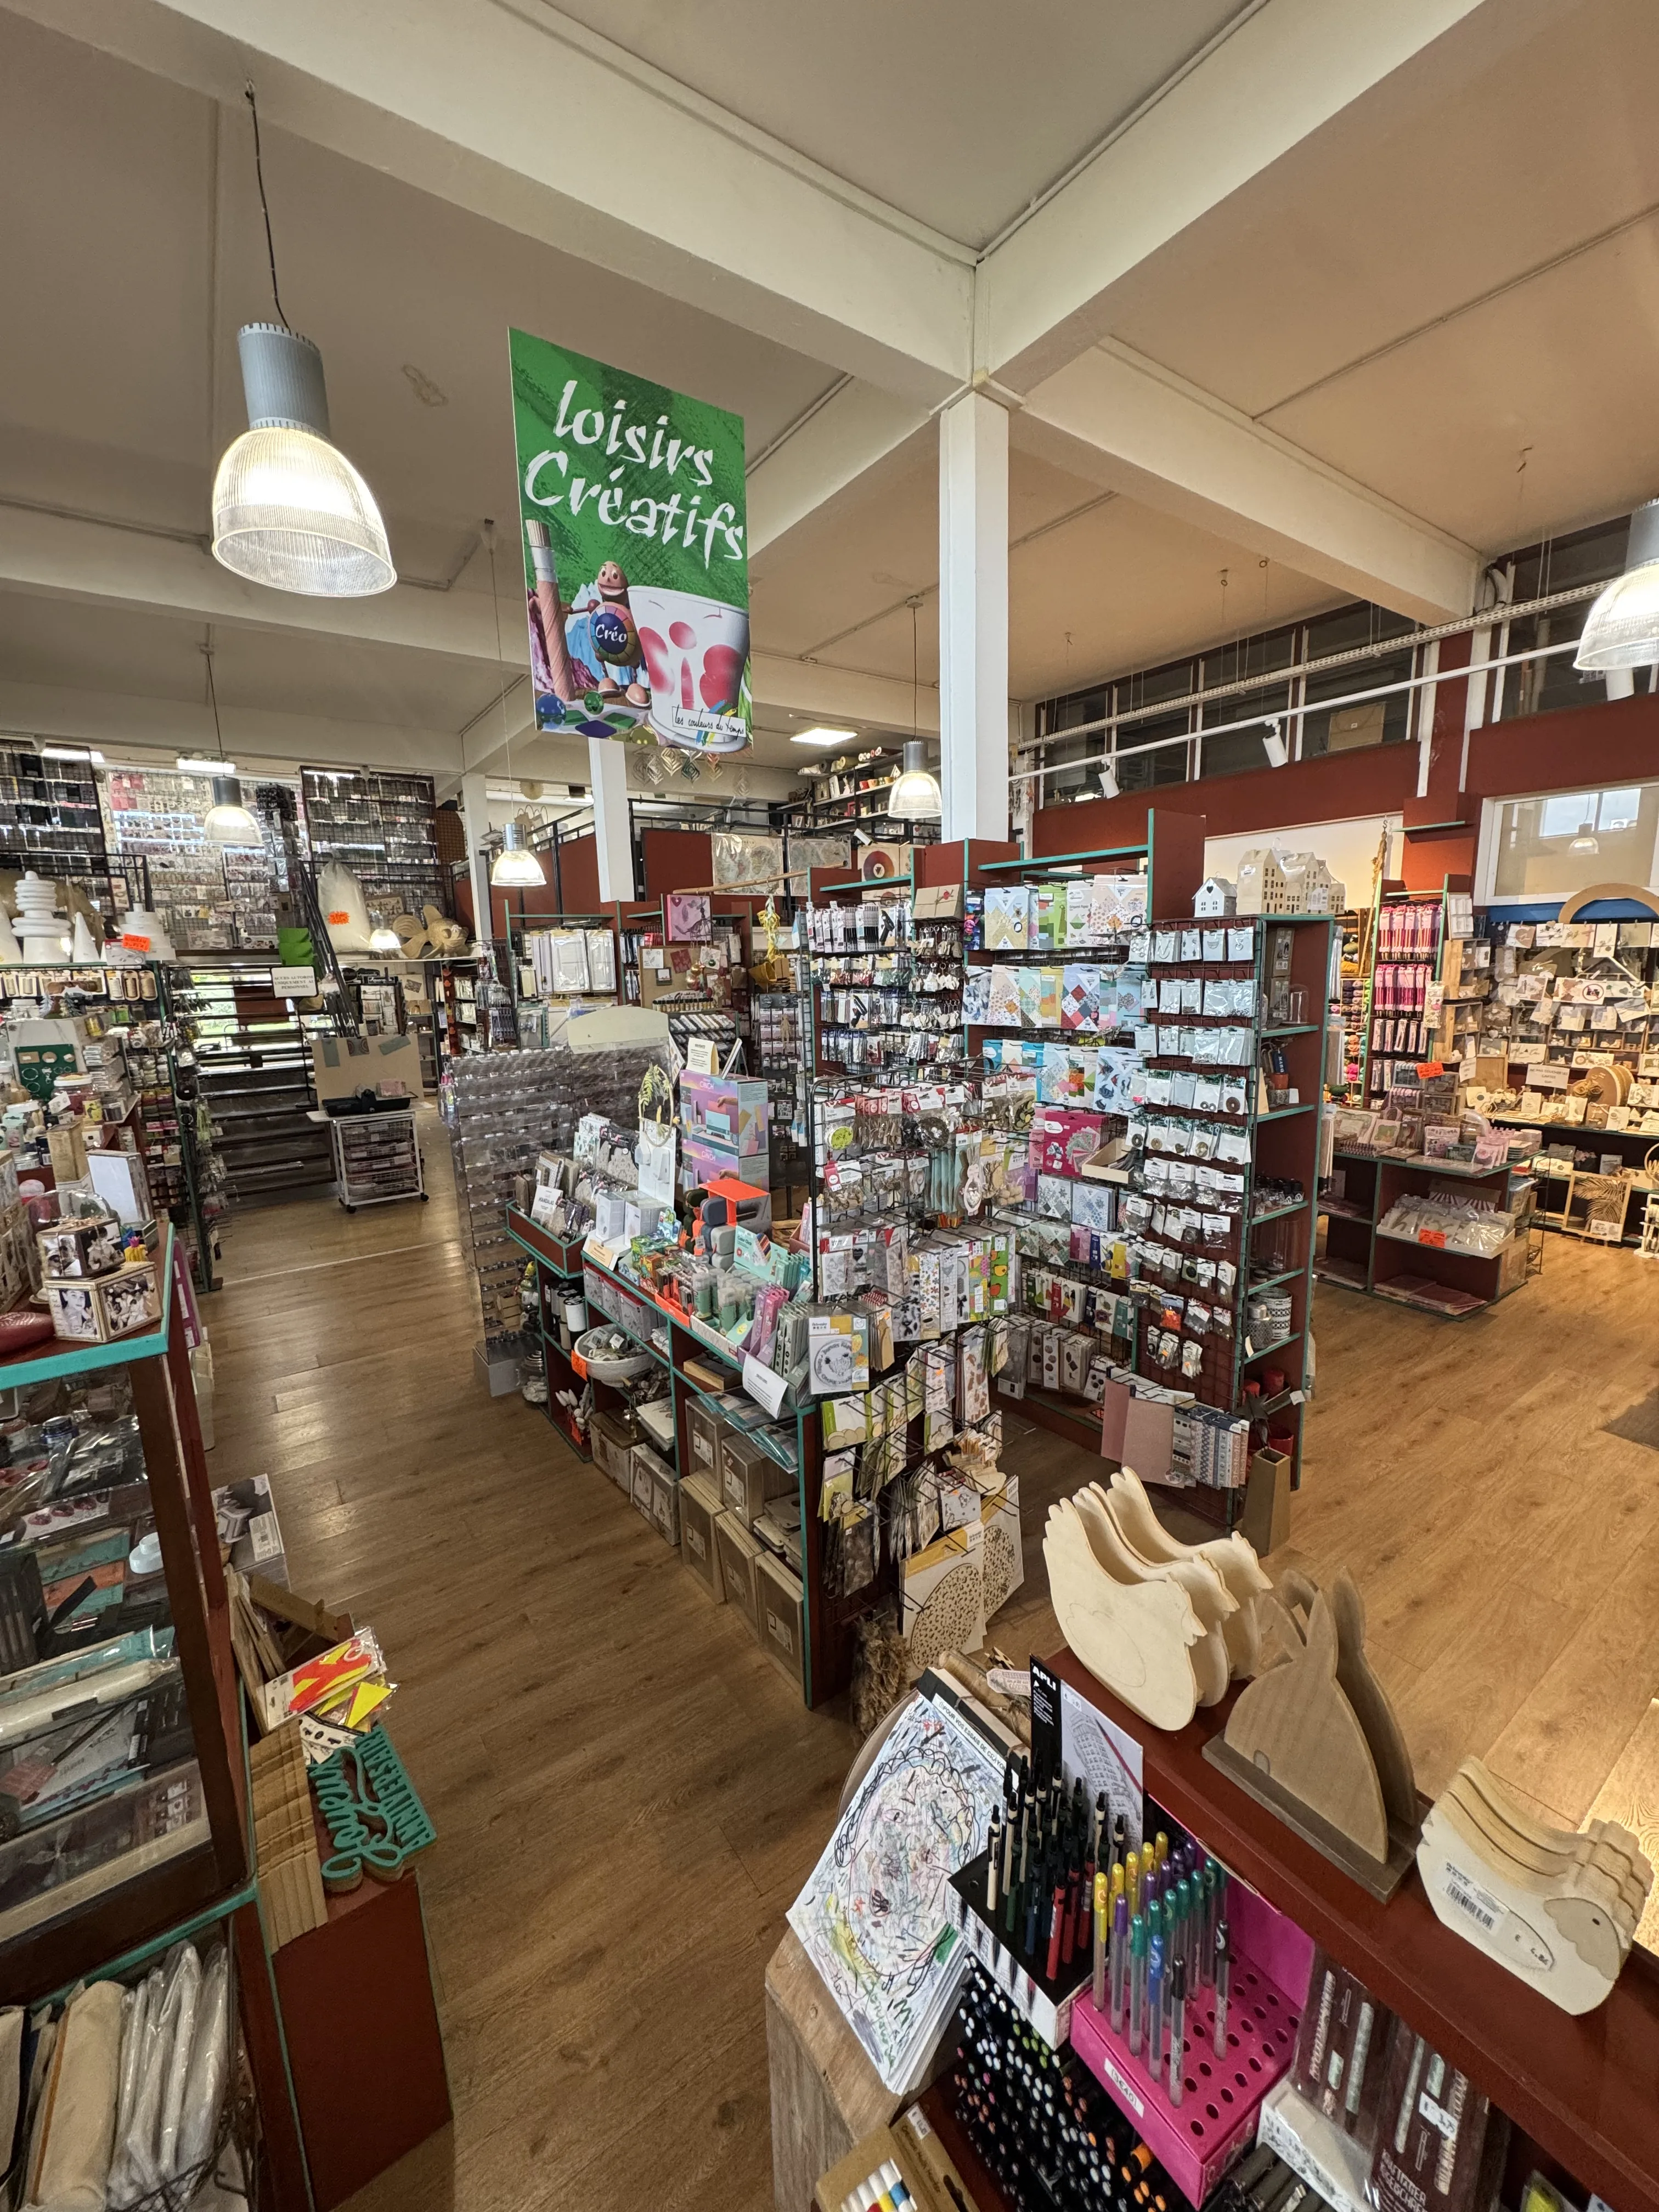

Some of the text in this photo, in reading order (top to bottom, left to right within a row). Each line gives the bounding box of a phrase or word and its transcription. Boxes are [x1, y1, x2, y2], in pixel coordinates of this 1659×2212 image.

[524, 449, 744, 569] Créatifs
[595, 624, 628, 644] Créo
[688, 708, 714, 731] couleurs
[715, 710, 724, 731] du
[725, 721, 746, 741] temps
[1032, 1665, 1057, 1691] APLI
[943, 1706, 956, 1720] POUR
